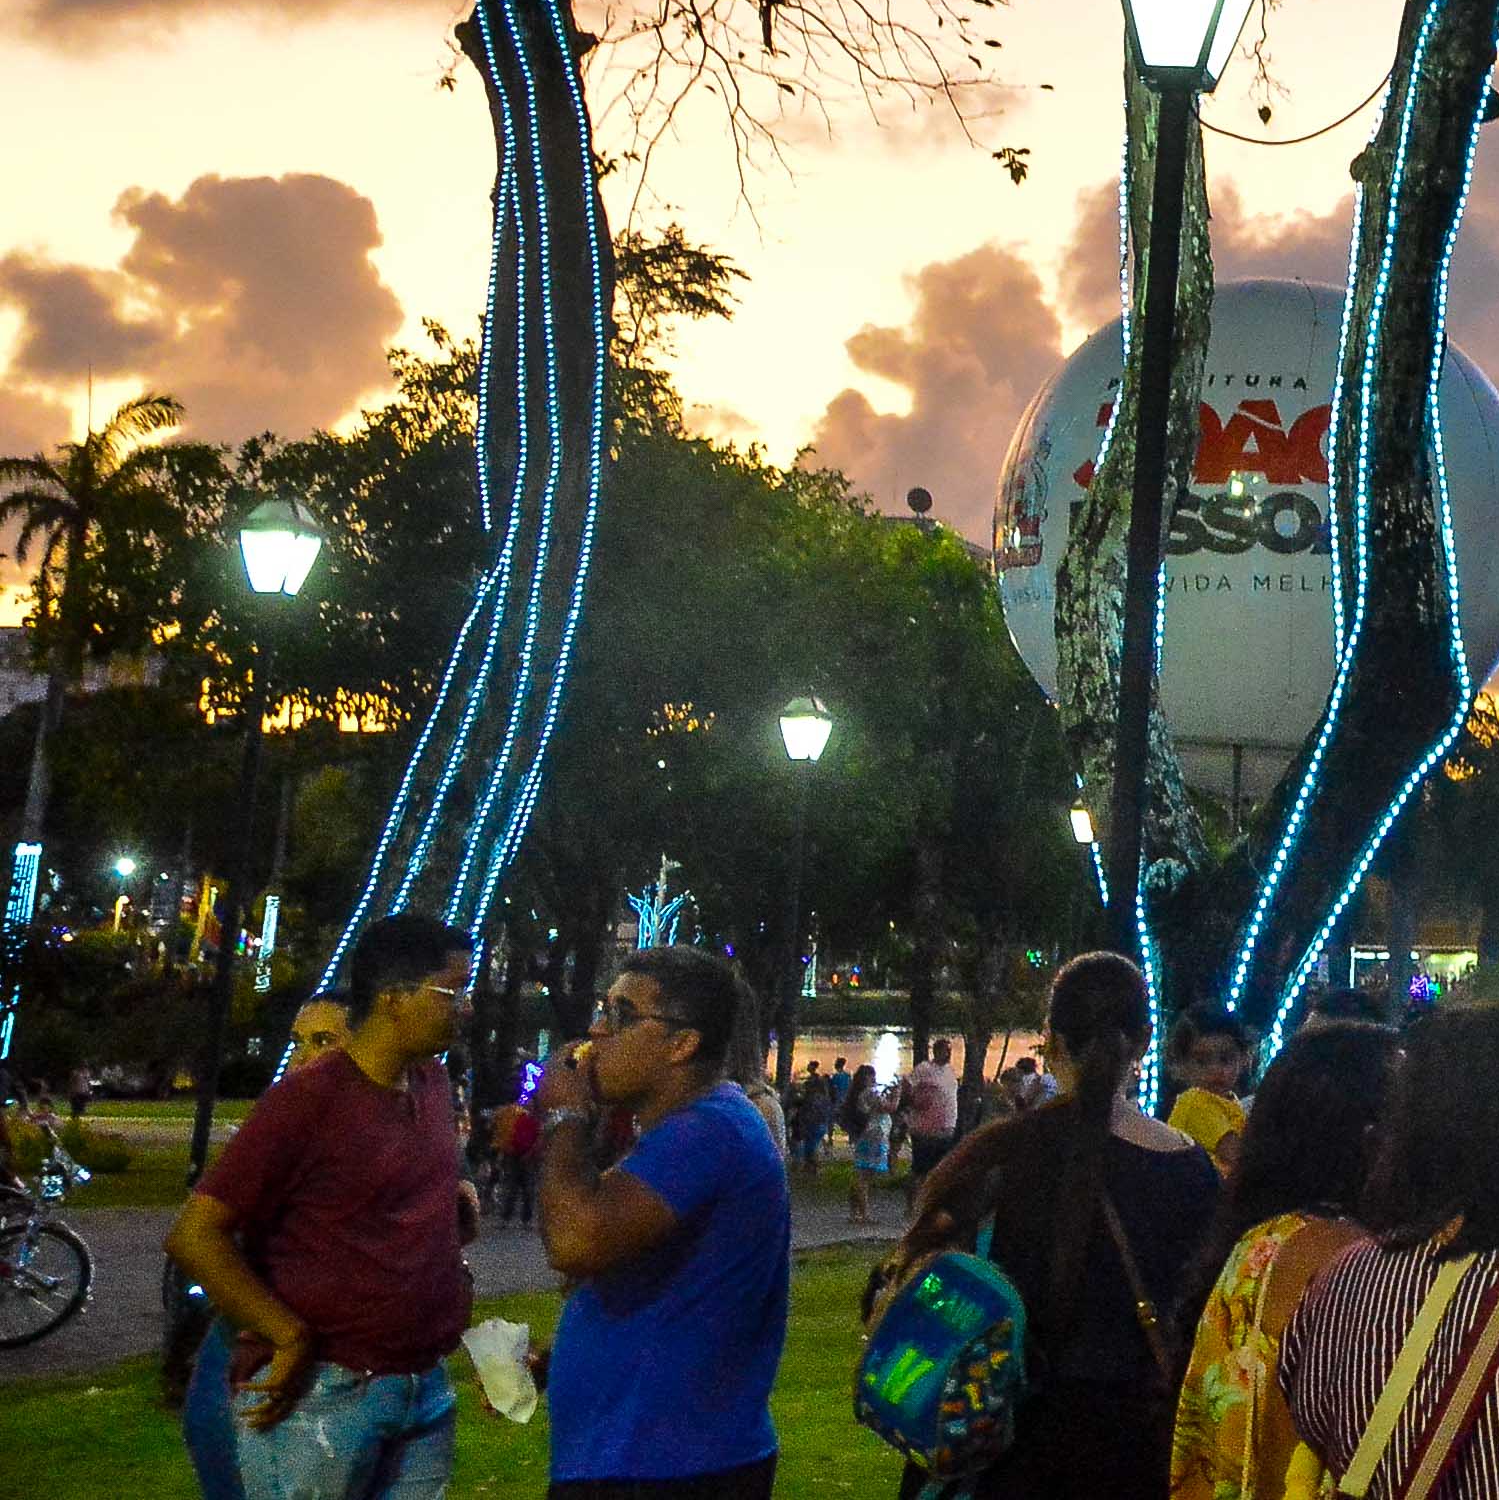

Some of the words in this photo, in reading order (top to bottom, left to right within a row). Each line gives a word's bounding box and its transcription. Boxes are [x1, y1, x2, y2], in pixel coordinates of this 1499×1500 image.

[1107, 374, 1307, 390] PITURA
[1069, 492, 1331, 554] SSO
[1253, 574, 1332, 592] MELH
